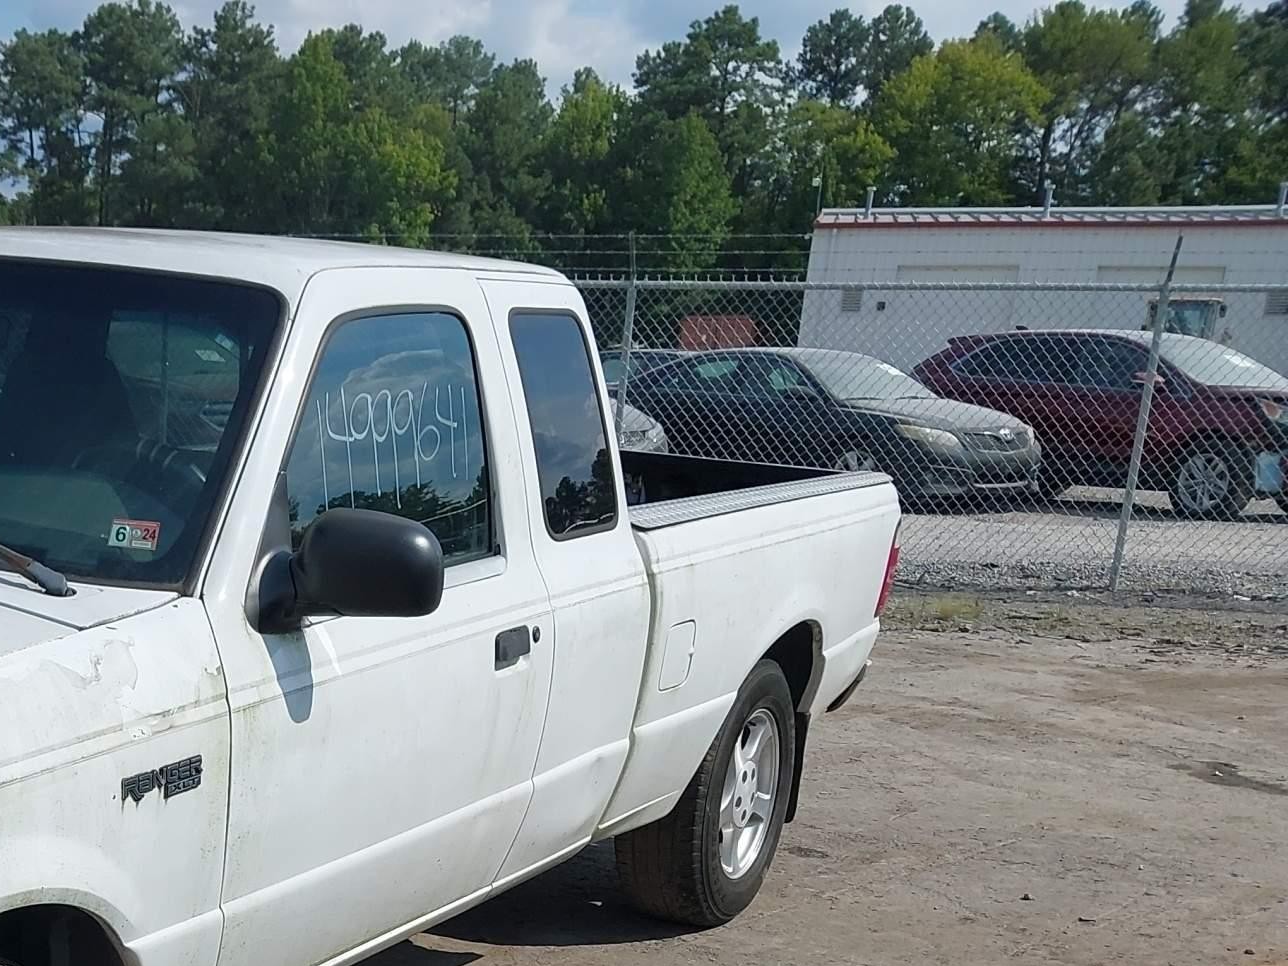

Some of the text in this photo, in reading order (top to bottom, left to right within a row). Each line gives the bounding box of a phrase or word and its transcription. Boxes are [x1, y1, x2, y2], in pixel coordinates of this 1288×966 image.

[115, 526, 157, 543] 6 24
[121, 754, 203, 802] RANGER
[168, 777, 201, 797] XLT
